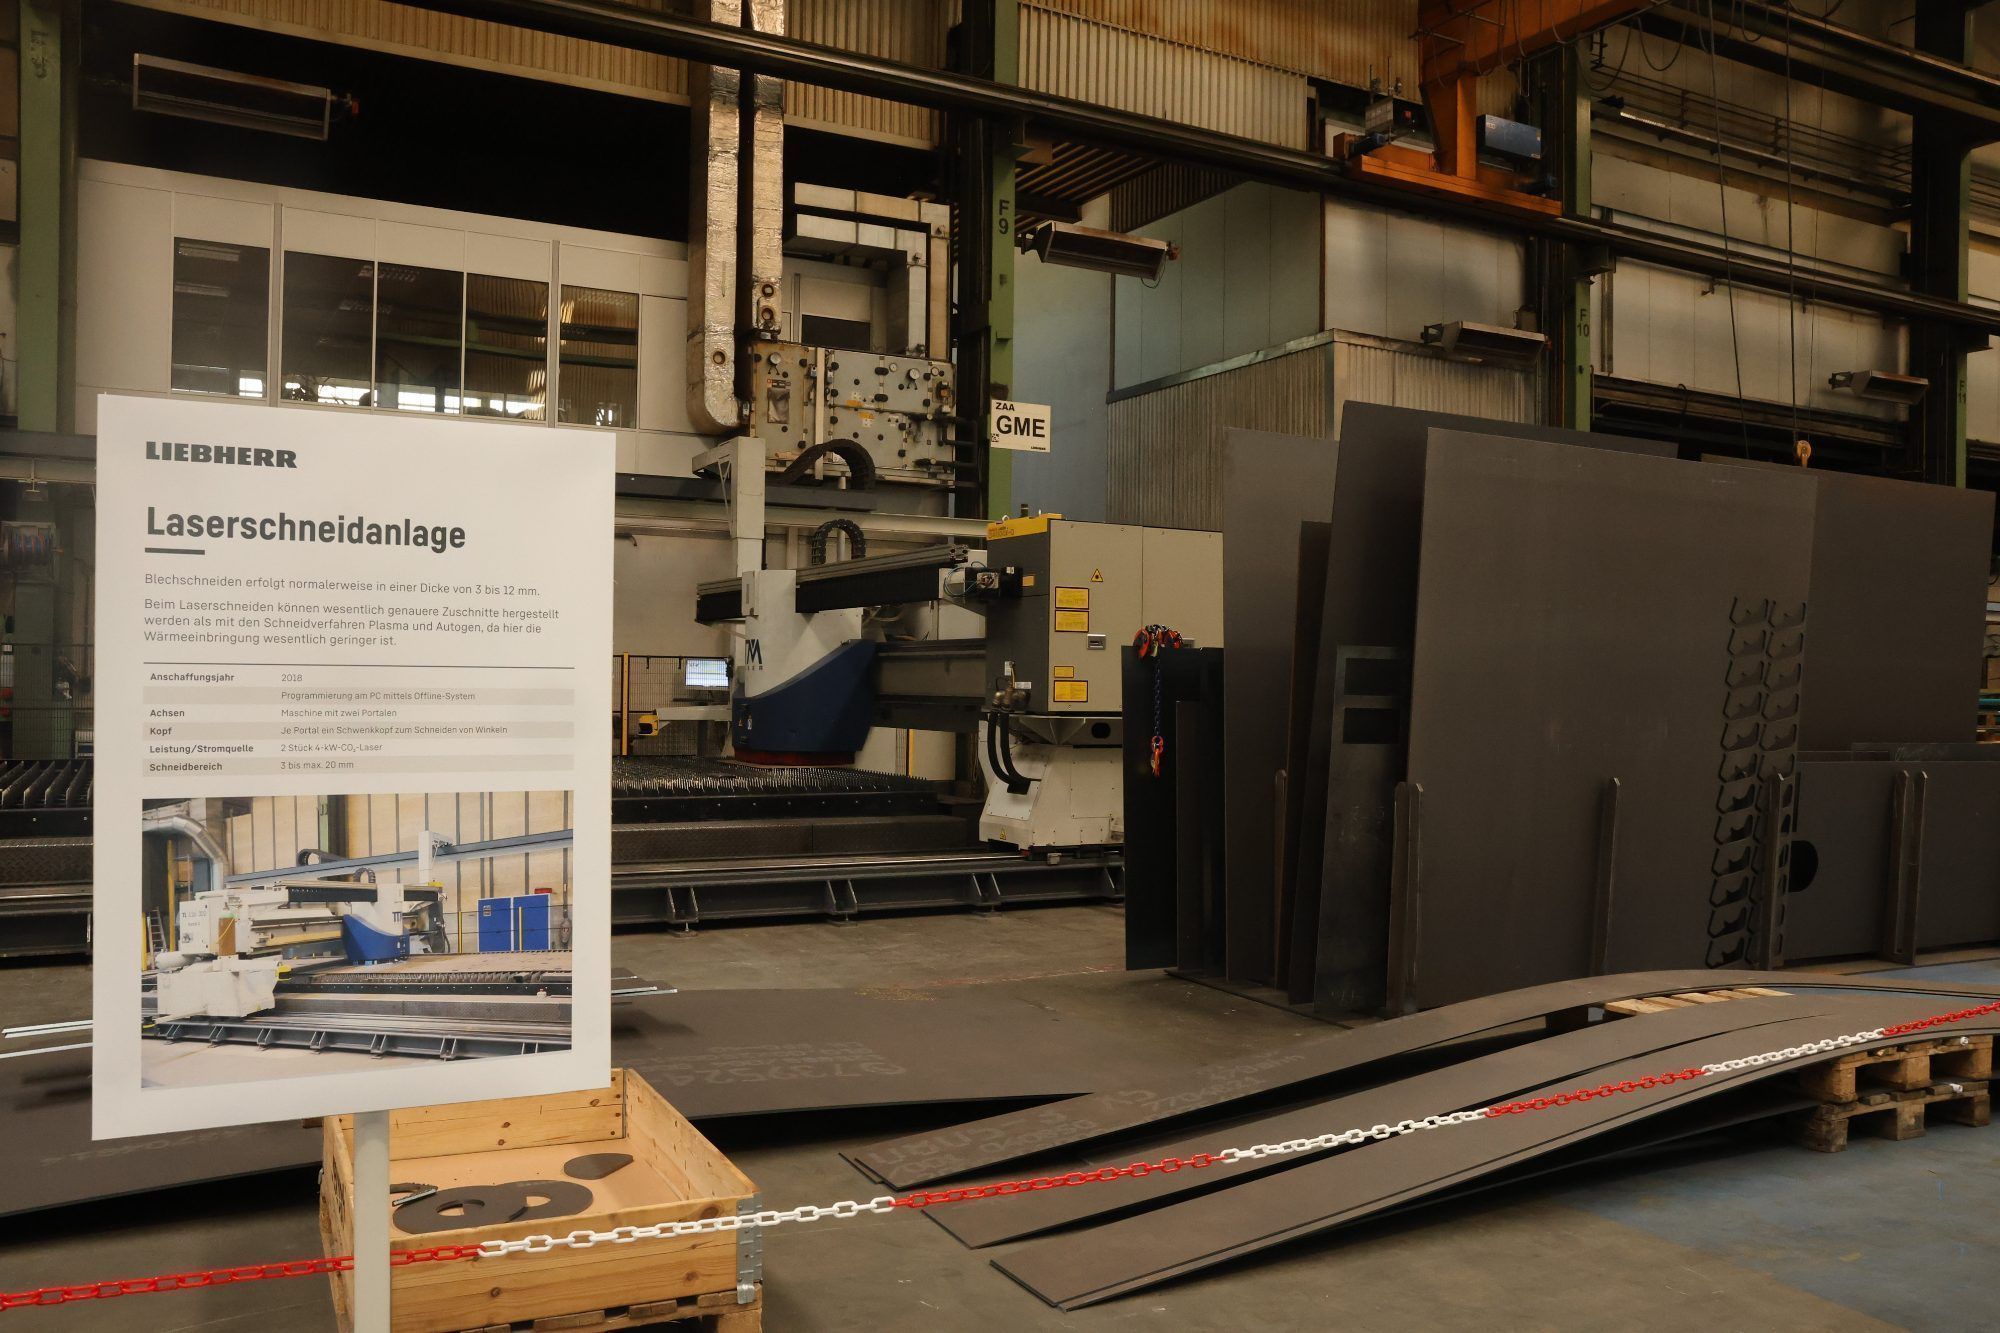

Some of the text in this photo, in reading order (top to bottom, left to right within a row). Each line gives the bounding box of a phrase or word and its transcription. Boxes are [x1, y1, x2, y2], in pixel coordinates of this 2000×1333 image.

[996, 402, 1015, 412] ZAA
[996, 415, 1046, 438] GME
[146, 441, 297, 468] LIEBHERR
[148, 507, 465, 554] Laserschneidanlage
[145, 573, 540, 596] Blechschneiden erfolgt normalerweise in einer Dicke von 3 bis 12 mm.
[145, 599, 559, 623] Beim Laserschneiden können wesentlich genauere Zuschnitte hergestellt
[144, 615, 541, 634] werden als mit den Schneidverfahren Plasma und Autogen, da hier die
[144, 631, 398, 648] Wärmeeinbringung wesentlich geringer ist.
[150, 673, 235, 682] Anschaffungsjahr
[282, 672, 302, 682] 2018
[282, 692, 352, 702] Programmierung
[370, 692, 381, 700] PC
[383, 692, 412, 700] mittels
[414, 692, 475, 702] Offline-System
[150, 709, 184, 717] Achsen
[282, 709, 397, 718] Maschine mit zwei Portalen
[150, 727, 172, 736] Kopf
[281, 727, 291, 735] Je
[294, 726, 319, 735] Portal
[322, 726, 335, 735] ein
[337, 726, 394, 736] Schwenkkopf
[414, 726, 458, 735] Schneiden
[475, 726, 507, 735] Winkeln
[150, 744, 254, 754] Leistung/Stromquelle
[281, 744, 286, 753] 2
[288, 743, 313, 753] Stück
[150, 762, 222, 771] Schneidbereich
[281, 762, 285, 770] 3
[288, 762, 301, 770] bis
[304, 762, 323, 770] max.
[326, 761, 337, 769] 20
